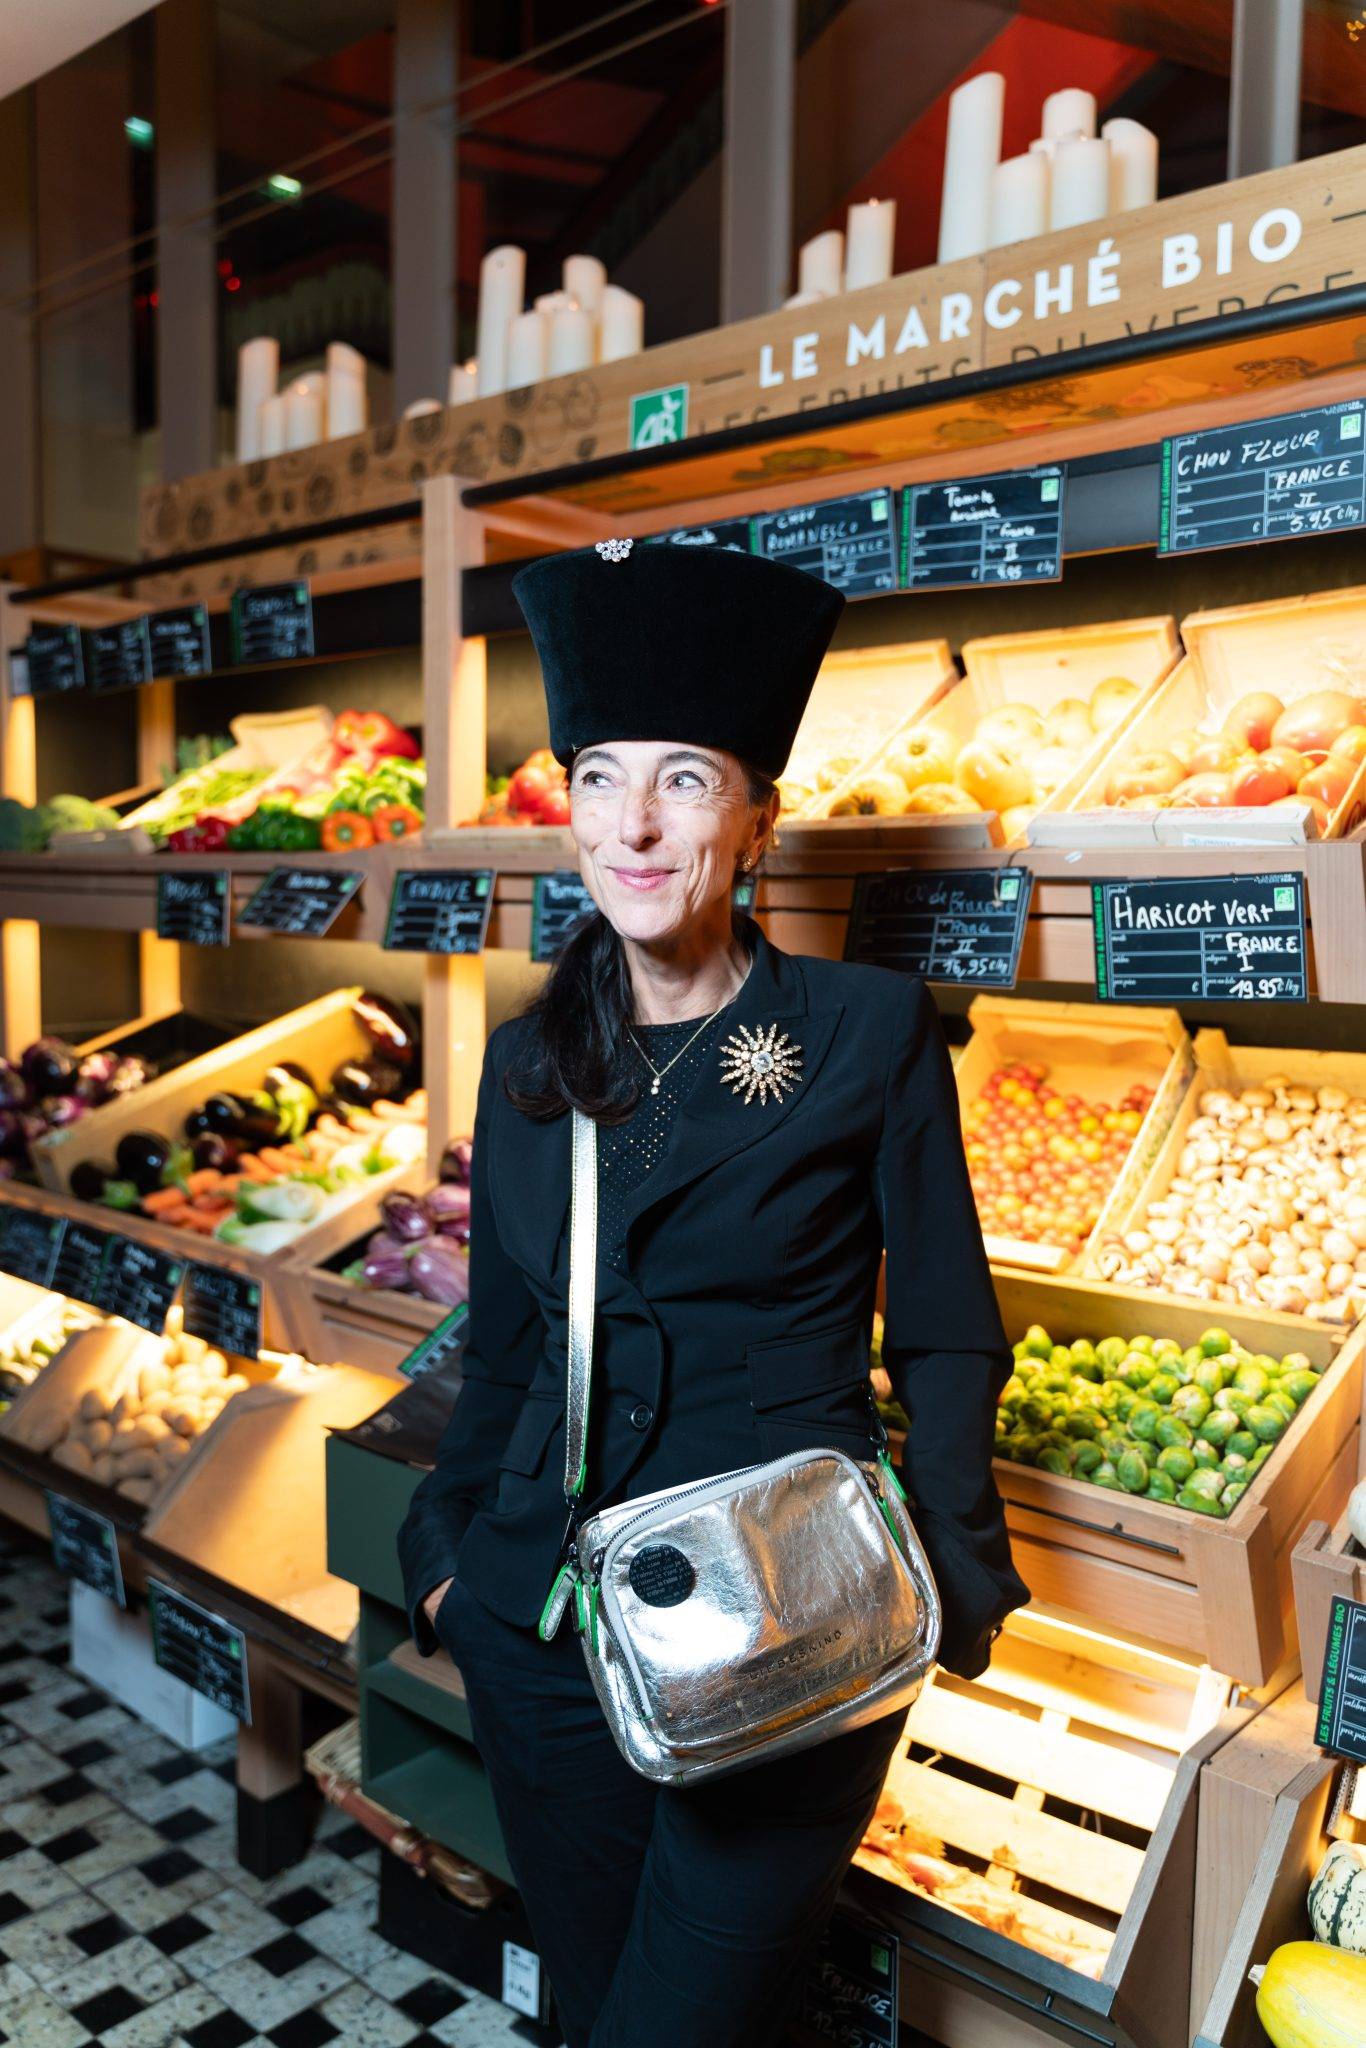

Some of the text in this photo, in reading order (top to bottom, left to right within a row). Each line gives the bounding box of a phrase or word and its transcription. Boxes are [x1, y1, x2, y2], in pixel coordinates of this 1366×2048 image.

[758, 331, 820, 389] LE
[845, 237, 1122, 367] MARCHÉ
[1162, 207, 1303, 289] BIO
[1241, 429, 1321, 464] FLEUR
[1275, 459, 1352, 490] FRANCE
[1225, 932, 1299, 953] FRANCE
[1229, 977, 1278, 999] 19.95
[1335, 1603, 1346, 1624] BIO
[1327, 1625, 1343, 1675] LÉGUMES
[1322, 1687, 1335, 1719] FRUITS
[1319, 1721, 1330, 1744] LES
